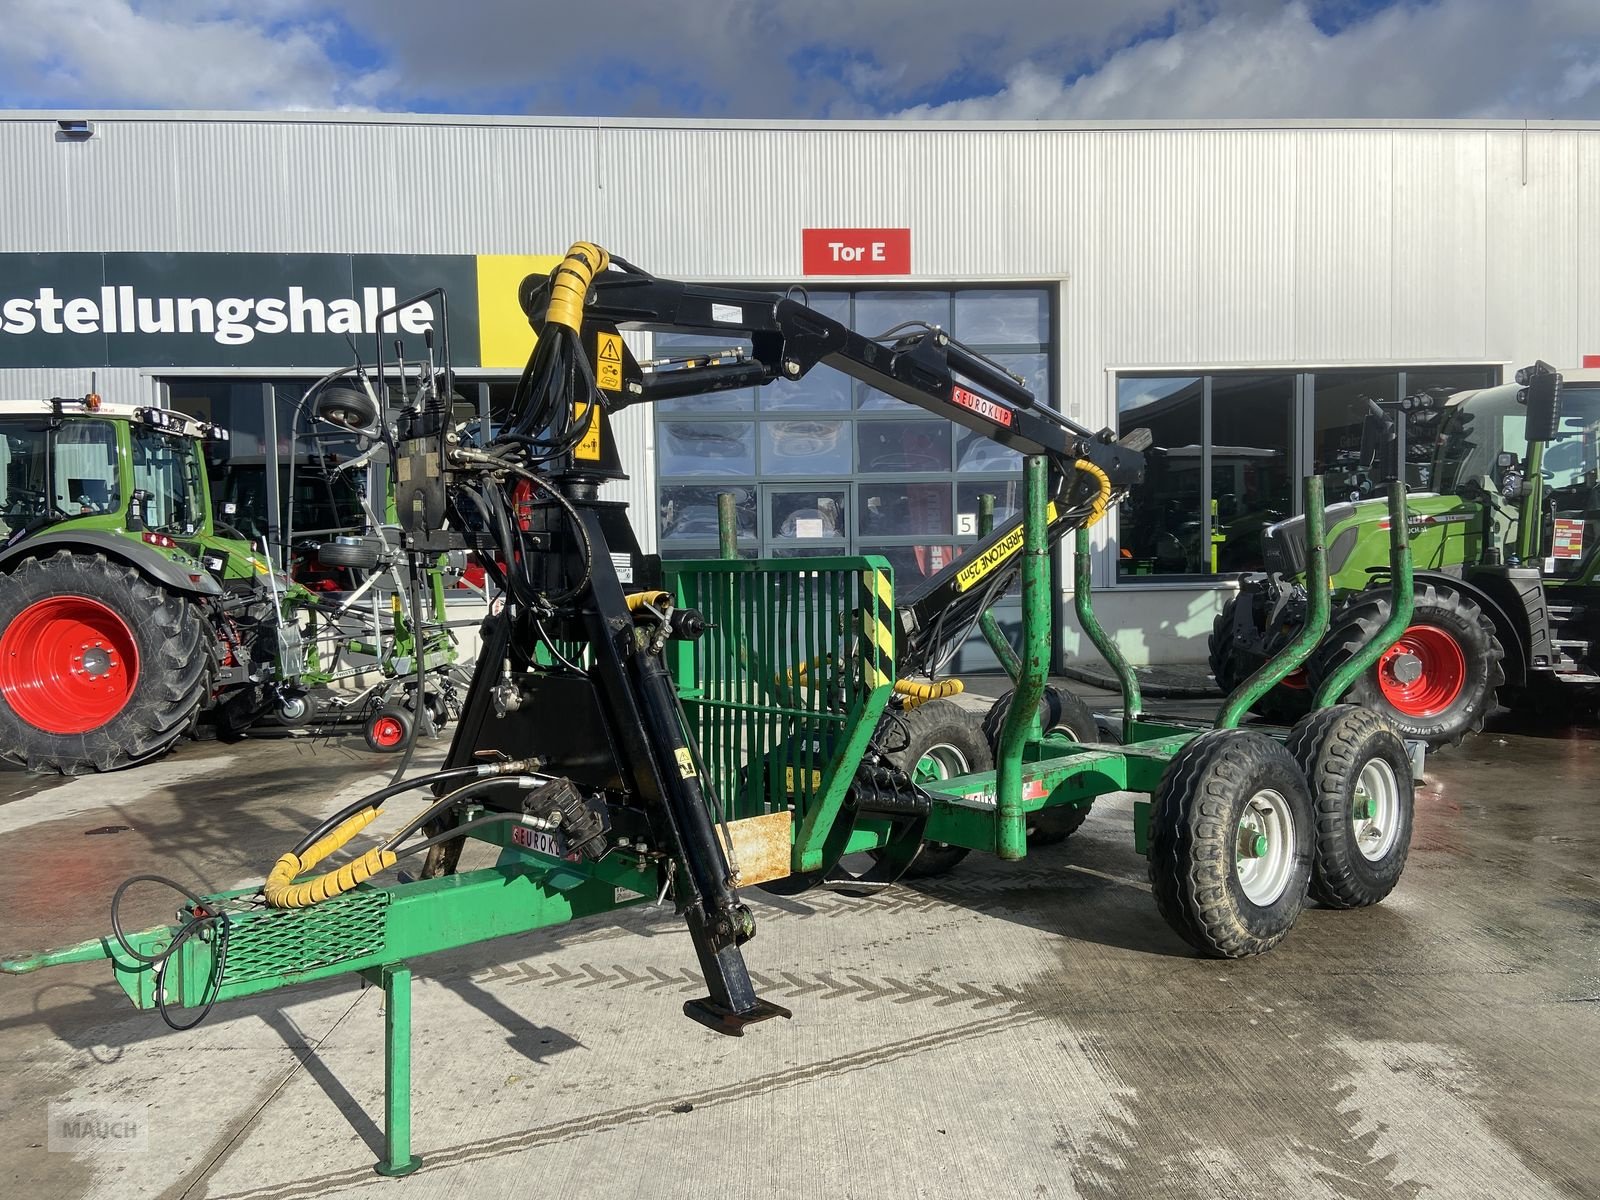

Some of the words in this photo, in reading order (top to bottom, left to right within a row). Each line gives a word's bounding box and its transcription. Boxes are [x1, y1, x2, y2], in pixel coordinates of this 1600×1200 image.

[828, 242, 865, 261] Tor
[871, 242, 886, 261] E
[0, 285, 435, 346] stellungshalle
[961, 391, 1009, 424] EUROKLIP
[961, 517, 971, 533] 5
[960, 560, 982, 582] 25m
